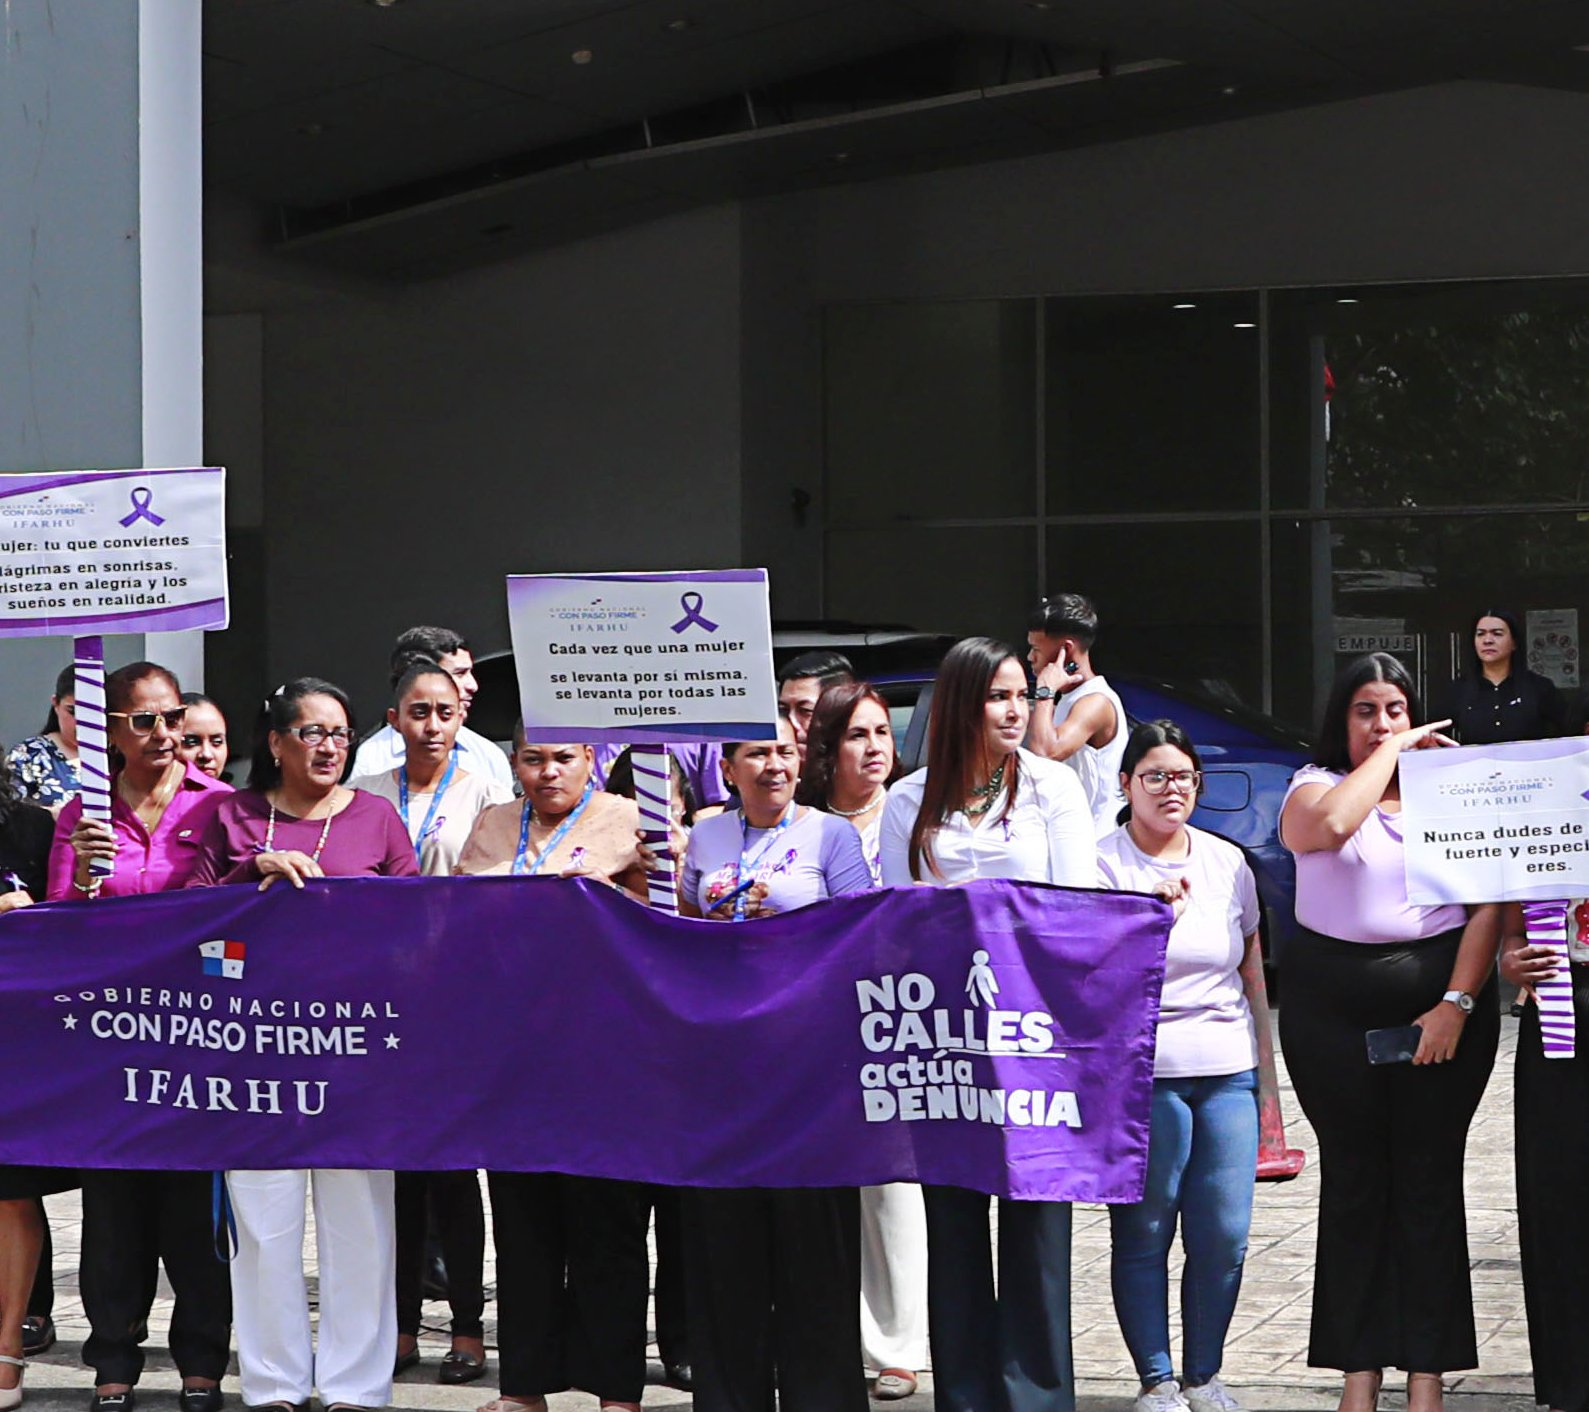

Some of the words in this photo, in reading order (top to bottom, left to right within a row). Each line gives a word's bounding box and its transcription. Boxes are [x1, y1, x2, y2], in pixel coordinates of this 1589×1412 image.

[2, 509, 24, 517] CON
[27, 508, 52, 516] PASO
[55, 507, 85, 515] FIRME
[13, 519, 75, 529] IFARHU
[44, 540, 60, 551] tu
[67, 539, 97, 552] que
[103, 536, 189, 549] conviertes
[77, 564, 97, 573] en
[59, 581, 79, 591] en
[85, 576, 142, 591] alegría
[148, 579, 157, 590] y
[163, 576, 187, 587] los
[8, 596, 66, 610] sueños
[72, 597, 92, 607] en
[98, 593, 171, 606] realidad.
[558, 612, 580, 620] CON
[581, 612, 607, 620] PASO
[608, 611, 638, 619] FIRME
[570, 623, 628, 632] IFARHU
[549, 642, 586, 655] Cada
[592, 643, 618, 654] vez
[624, 643, 652, 656] que
[658, 643, 689, 654] una
[695, 640, 745, 654] mujer
[1339, 637, 1412, 649] EMPUJE
[550, 673, 567, 683] se
[572, 671, 628, 683] levanta
[633, 672, 658, 685] por
[664, 669, 678, 682] sí
[555, 689, 572, 699] se
[577, 688, 632, 700] levanta
[638, 688, 663, 702] por
[669, 687, 714, 698] todas
[721, 686, 746, 697] las
[614, 704, 681, 718] mujeres.
[1449, 788, 1474, 796] CON
[1477, 786, 1507, 794] PASO
[1509, 782, 1543, 791] FIRME
[1463, 794, 1532, 807] IFARHU
[1423, 830, 1484, 843] Nunca
[1493, 826, 1552, 840] dudes
[1561, 822, 1583, 835] de
[1445, 846, 1502, 860] fuerte
[1510, 844, 1520, 858] y
[1526, 859, 1572, 873] eres.
[855, 973, 936, 1013] NO
[54, 987, 213, 1010] GOBIERNO
[229, 996, 399, 1018] NACIONAL
[90, 1010, 161, 1042] CON
[169, 1014, 246, 1052] PASO
[255, 1024, 368, 1055] FIRME
[860, 1008, 1055, 1053] CALLES
[860, 1048, 974, 1089] actúa
[124, 1067, 328, 1115] IFARHU
[863, 1086, 1082, 1128] DENUNCIA
